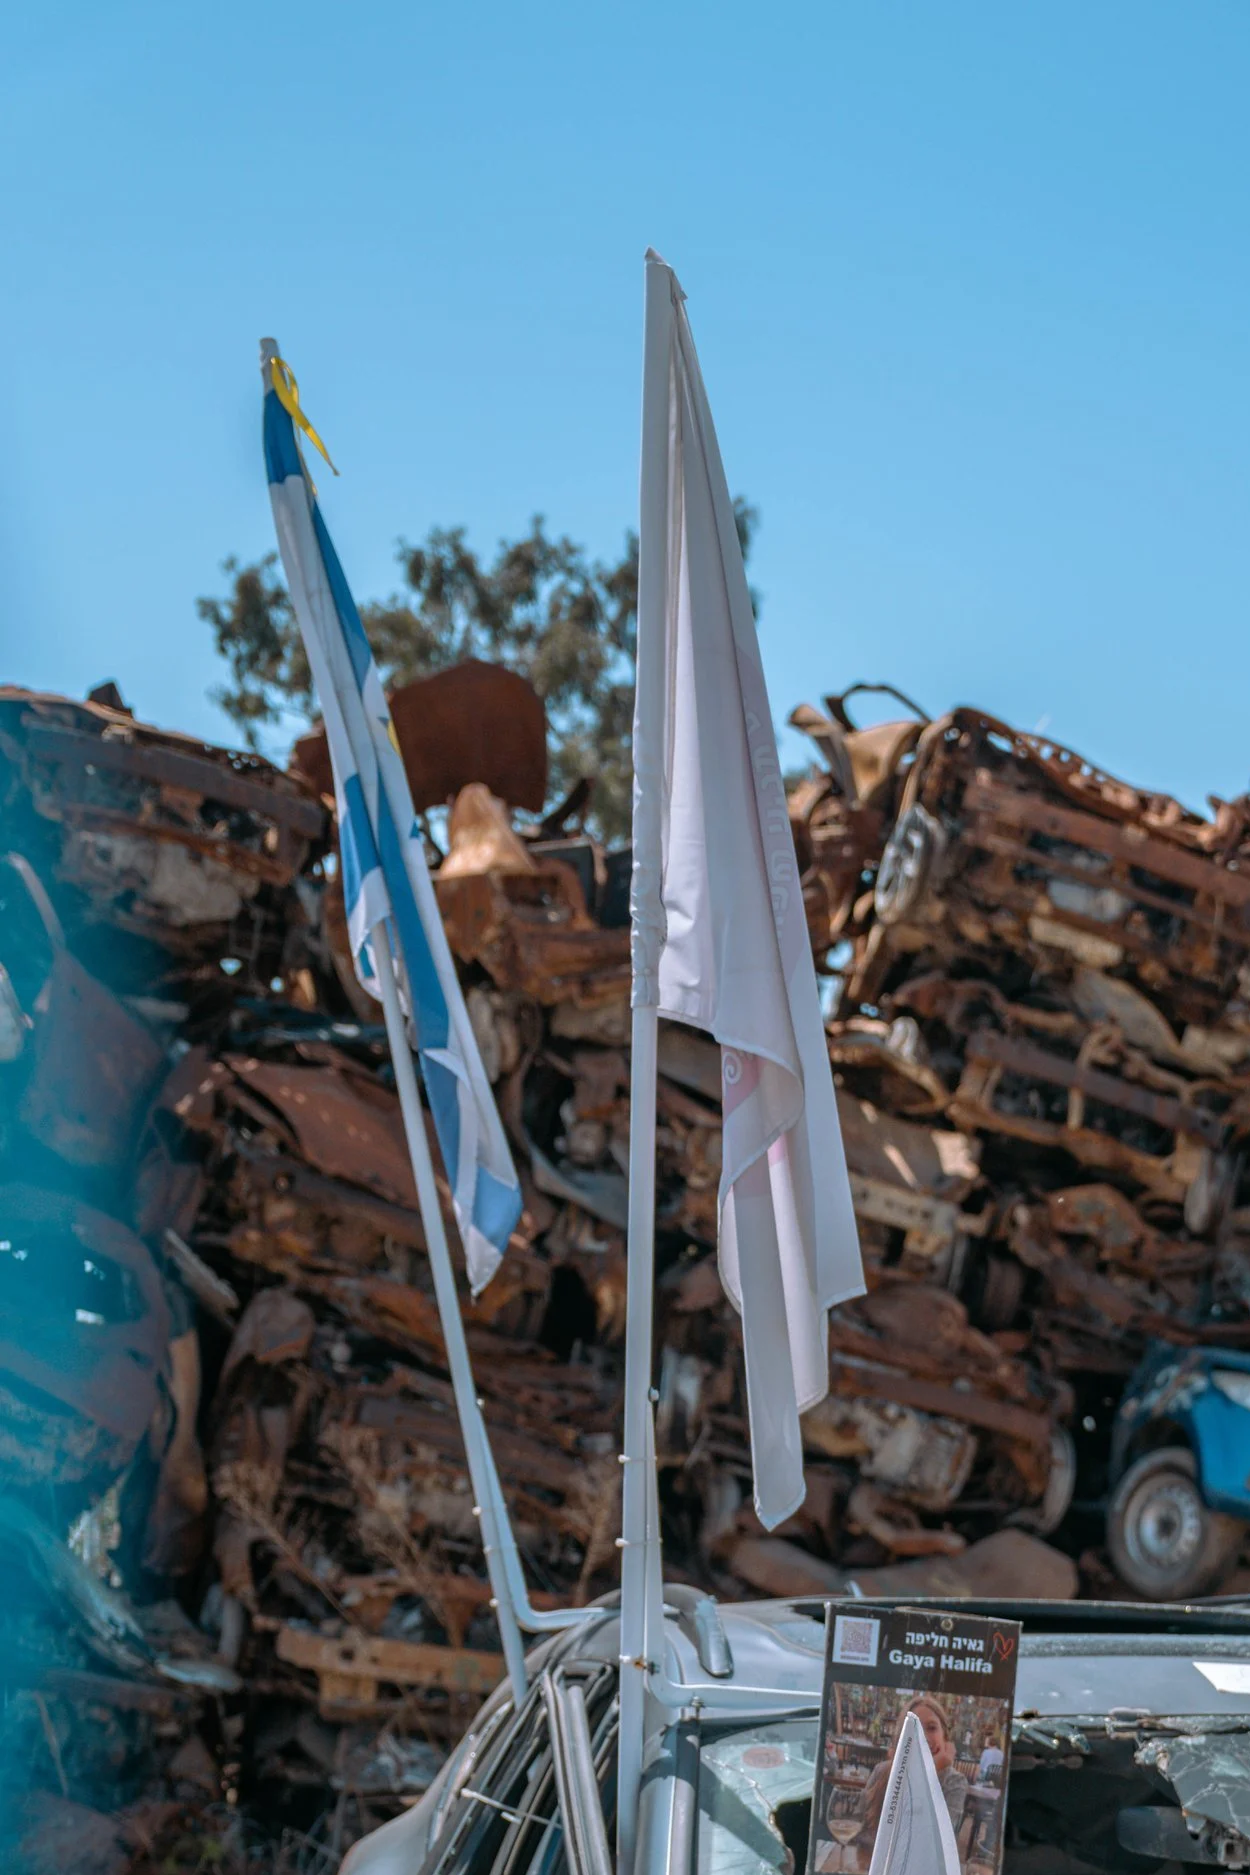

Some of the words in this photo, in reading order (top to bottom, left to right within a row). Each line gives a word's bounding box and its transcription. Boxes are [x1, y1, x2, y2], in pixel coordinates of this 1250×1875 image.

[905, 1631, 949, 1649] חליפה
[952, 1636, 985, 1652] גאיה
[889, 1649, 935, 1670] Gaya
[940, 1654, 993, 1674] Halifa
